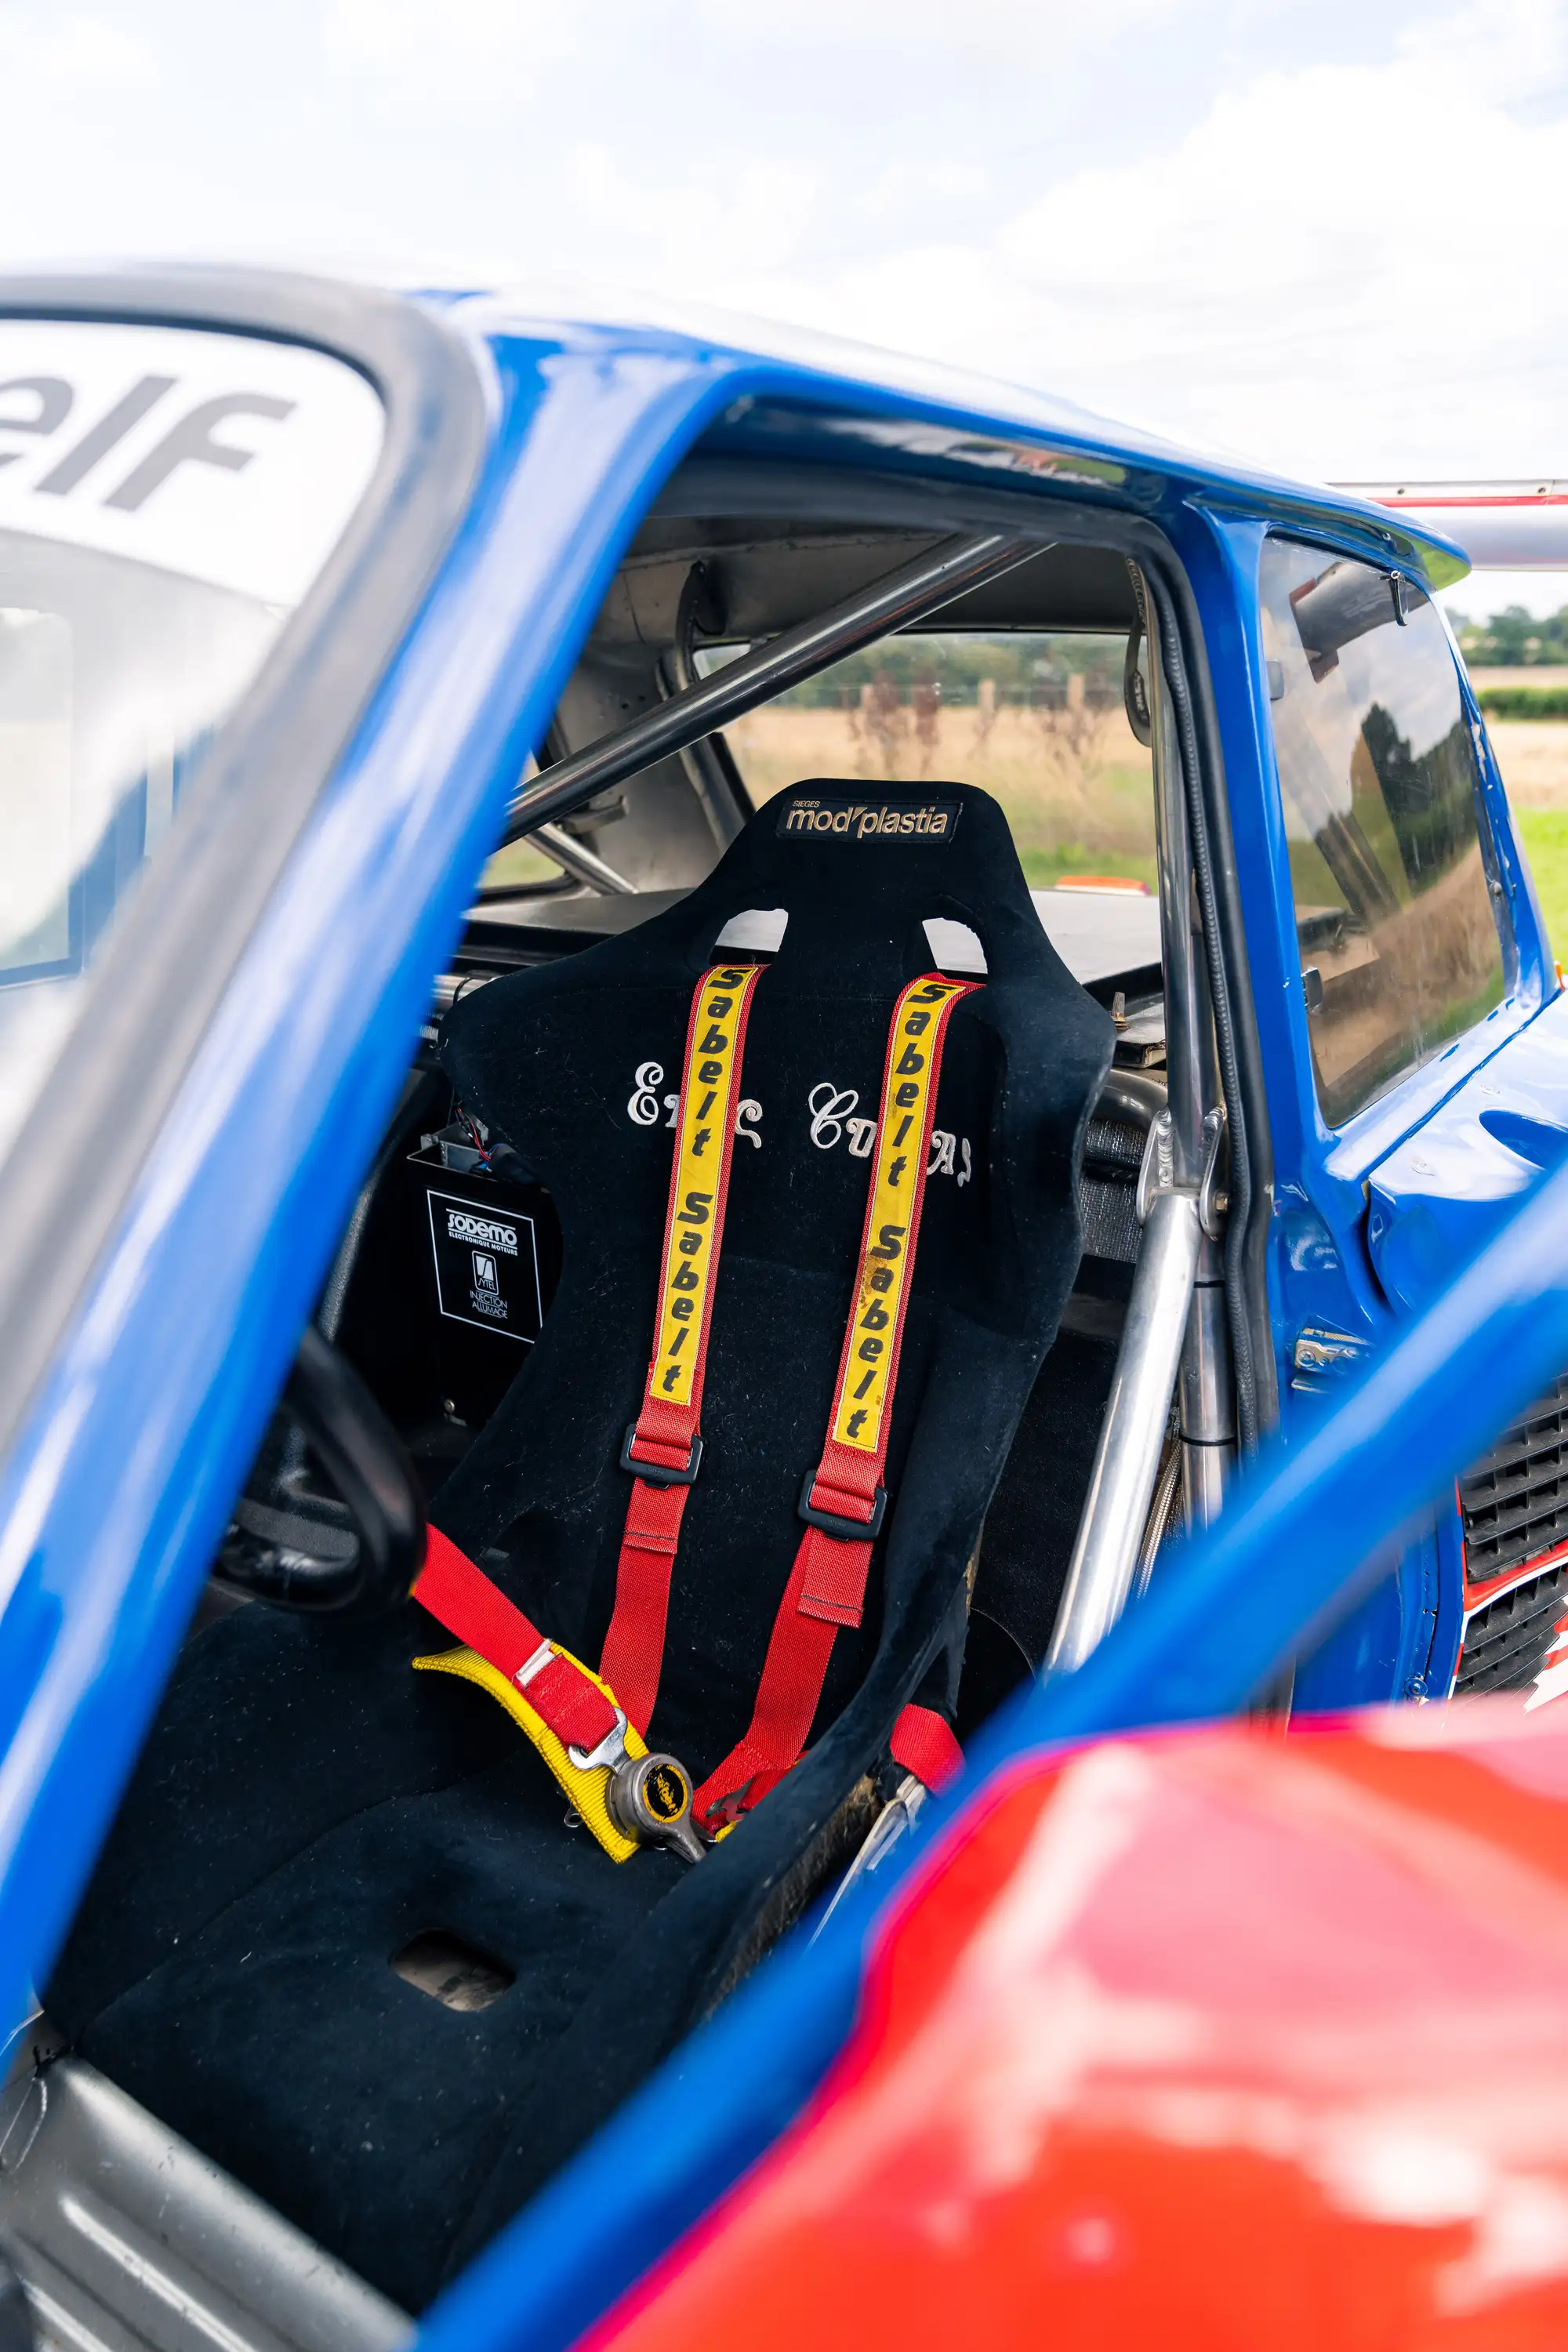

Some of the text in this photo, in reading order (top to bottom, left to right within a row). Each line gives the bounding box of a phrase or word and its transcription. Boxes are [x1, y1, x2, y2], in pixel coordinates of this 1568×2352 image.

[0, 376, 298, 513] elf
[792, 800, 821, 808] SIEGES
[661, 968, 751, 1393] Sabelt Sabelt
[846, 983, 957, 1439] Sabelt Sabelt
[448, 1231, 518, 1256] ELECTRONIQUE MOTEURS
[470, 1290, 508, 1308] INJECTION
[472, 1301, 508, 1319] ALLUMAGE
